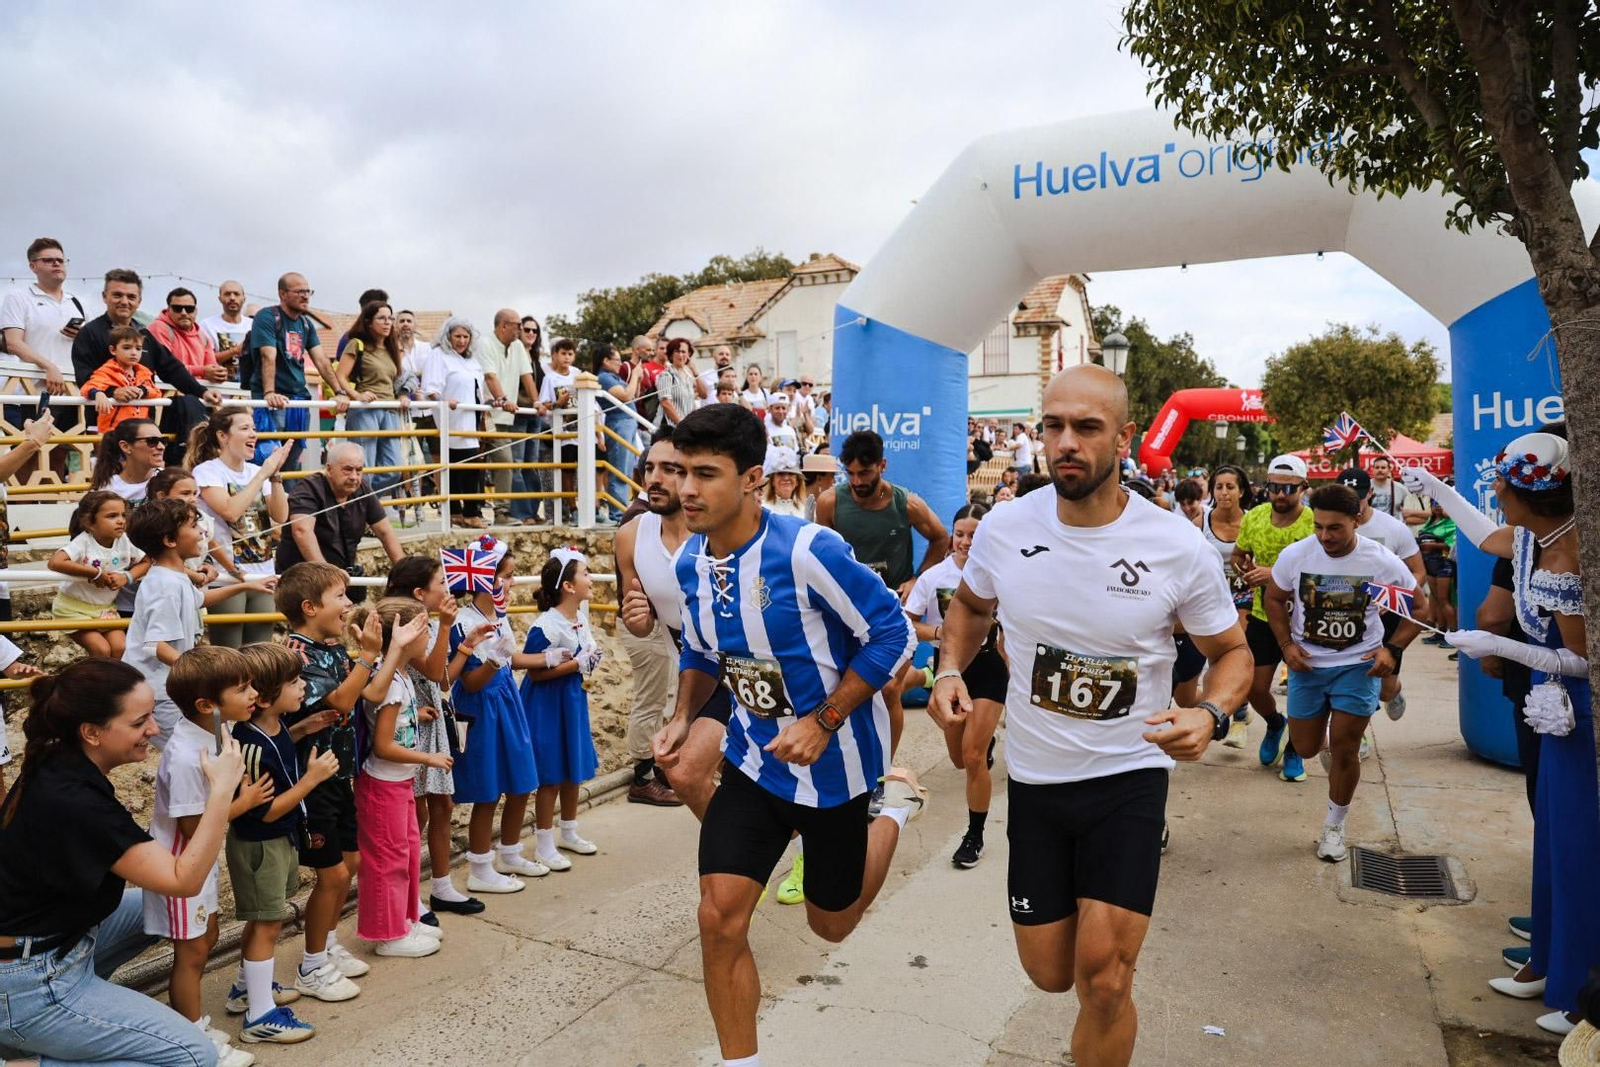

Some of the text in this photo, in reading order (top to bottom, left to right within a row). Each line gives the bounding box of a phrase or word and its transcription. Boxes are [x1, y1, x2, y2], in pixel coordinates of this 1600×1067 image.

[1013, 122, 1342, 200] Huelva origial
[829, 403, 920, 436] Huelva
[883, 438, 920, 452] riginal
[1316, 620, 1356, 638] 200
[1047, 671, 1122, 711] 167
